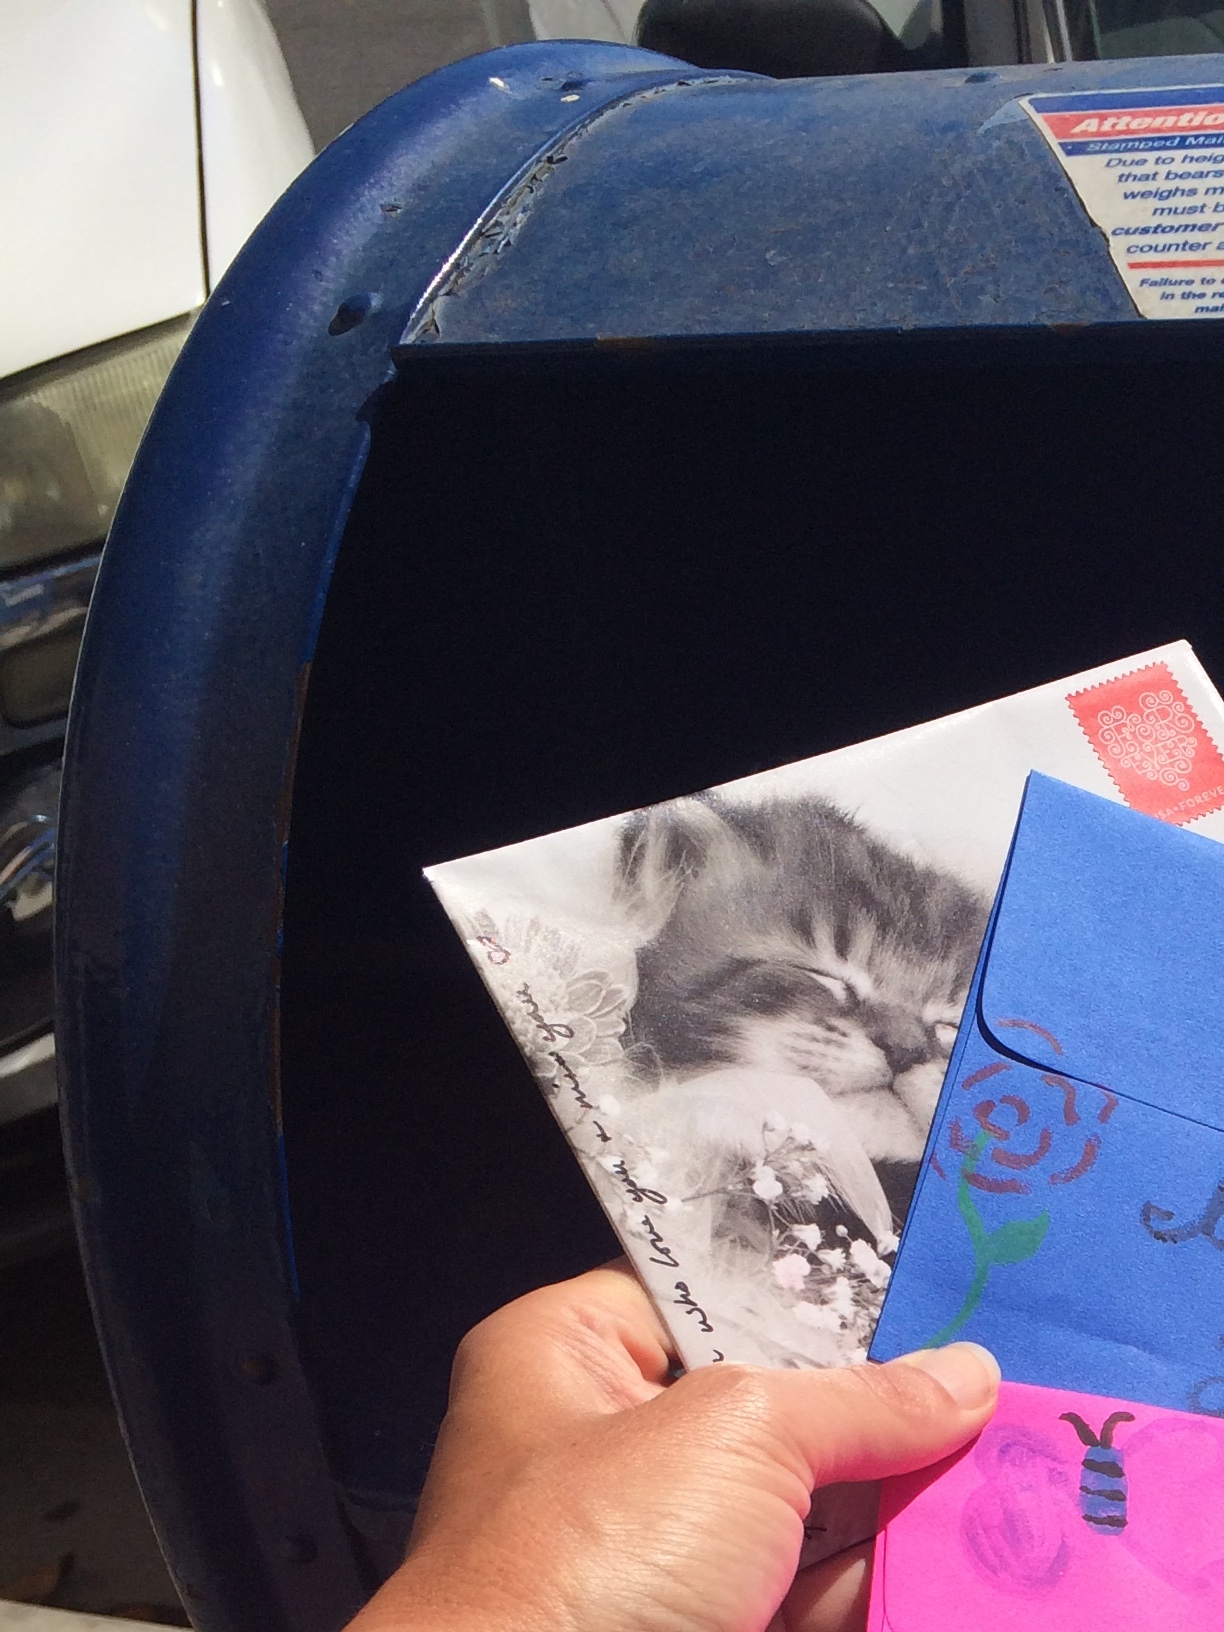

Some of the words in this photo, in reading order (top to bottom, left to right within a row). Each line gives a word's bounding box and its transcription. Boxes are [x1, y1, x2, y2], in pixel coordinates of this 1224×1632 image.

[1087, 135, 1181, 151] Stamped
[1105, 154, 1150, 168] Due
[1154, 152, 1176, 166] to
[1118, 169, 1160, 183] that
[1164, 167, 1224, 181] bears
[1123, 185, 1198, 201] weighs
[1152, 203, 1207, 217] must
[1111, 220, 1224, 237] customer
[1126, 239, 1213, 255] counter
[1139, 276, 1195, 288] Failure
[1200, 275, 1216, 286] to
[1160, 289, 1175, 301] in
[1180, 288, 1206, 300] the
[613, 1160, 668, 1204] you
